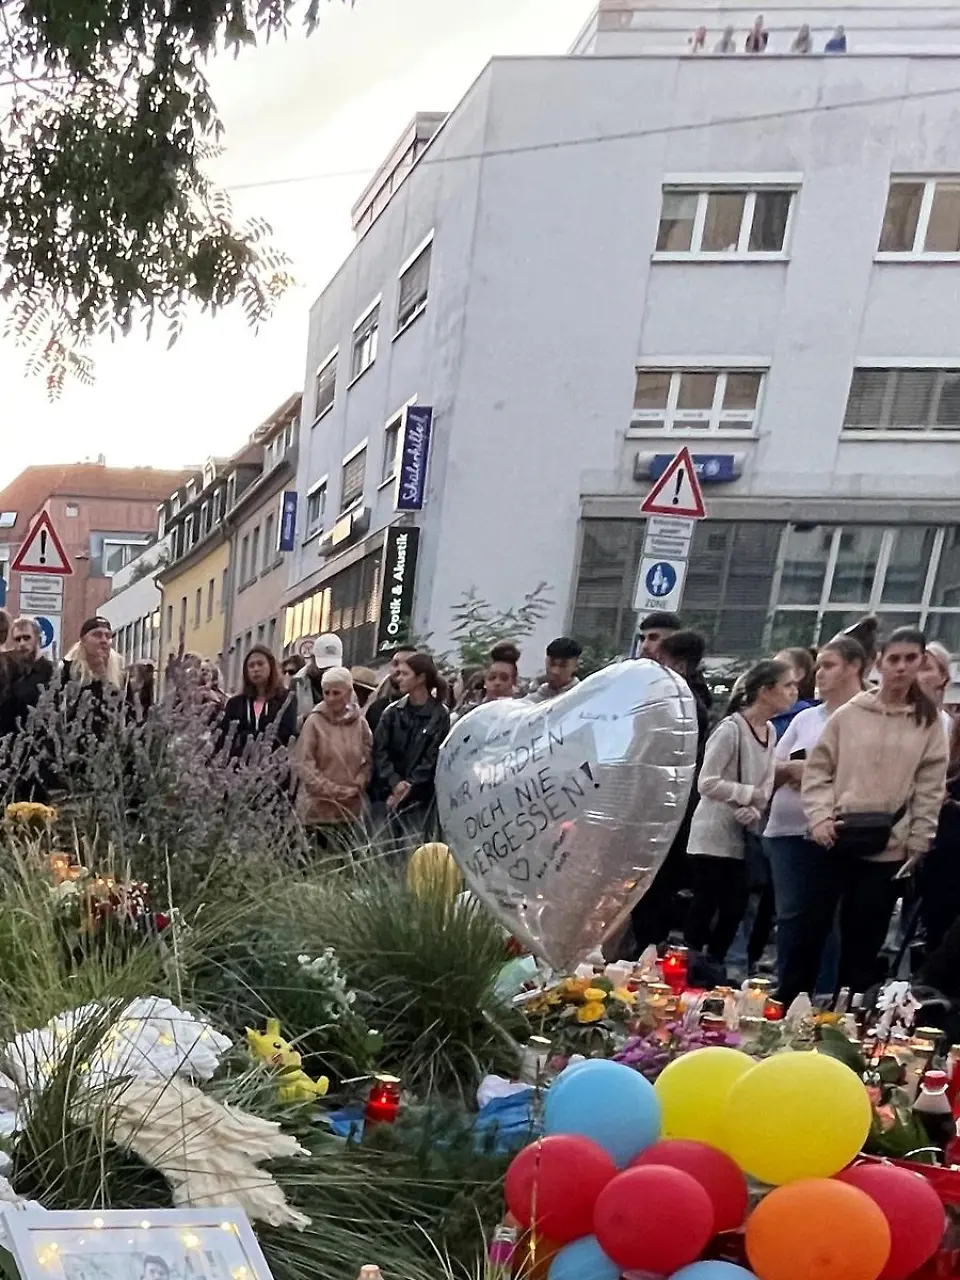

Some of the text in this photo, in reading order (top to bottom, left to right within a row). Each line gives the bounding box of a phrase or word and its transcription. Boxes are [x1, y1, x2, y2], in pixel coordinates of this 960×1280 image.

[392, 532, 409, 580] Akustik
[391, 580, 403, 596] &
[387, 597, 402, 635] Optik
[464, 766, 556, 840] DICH NIE
